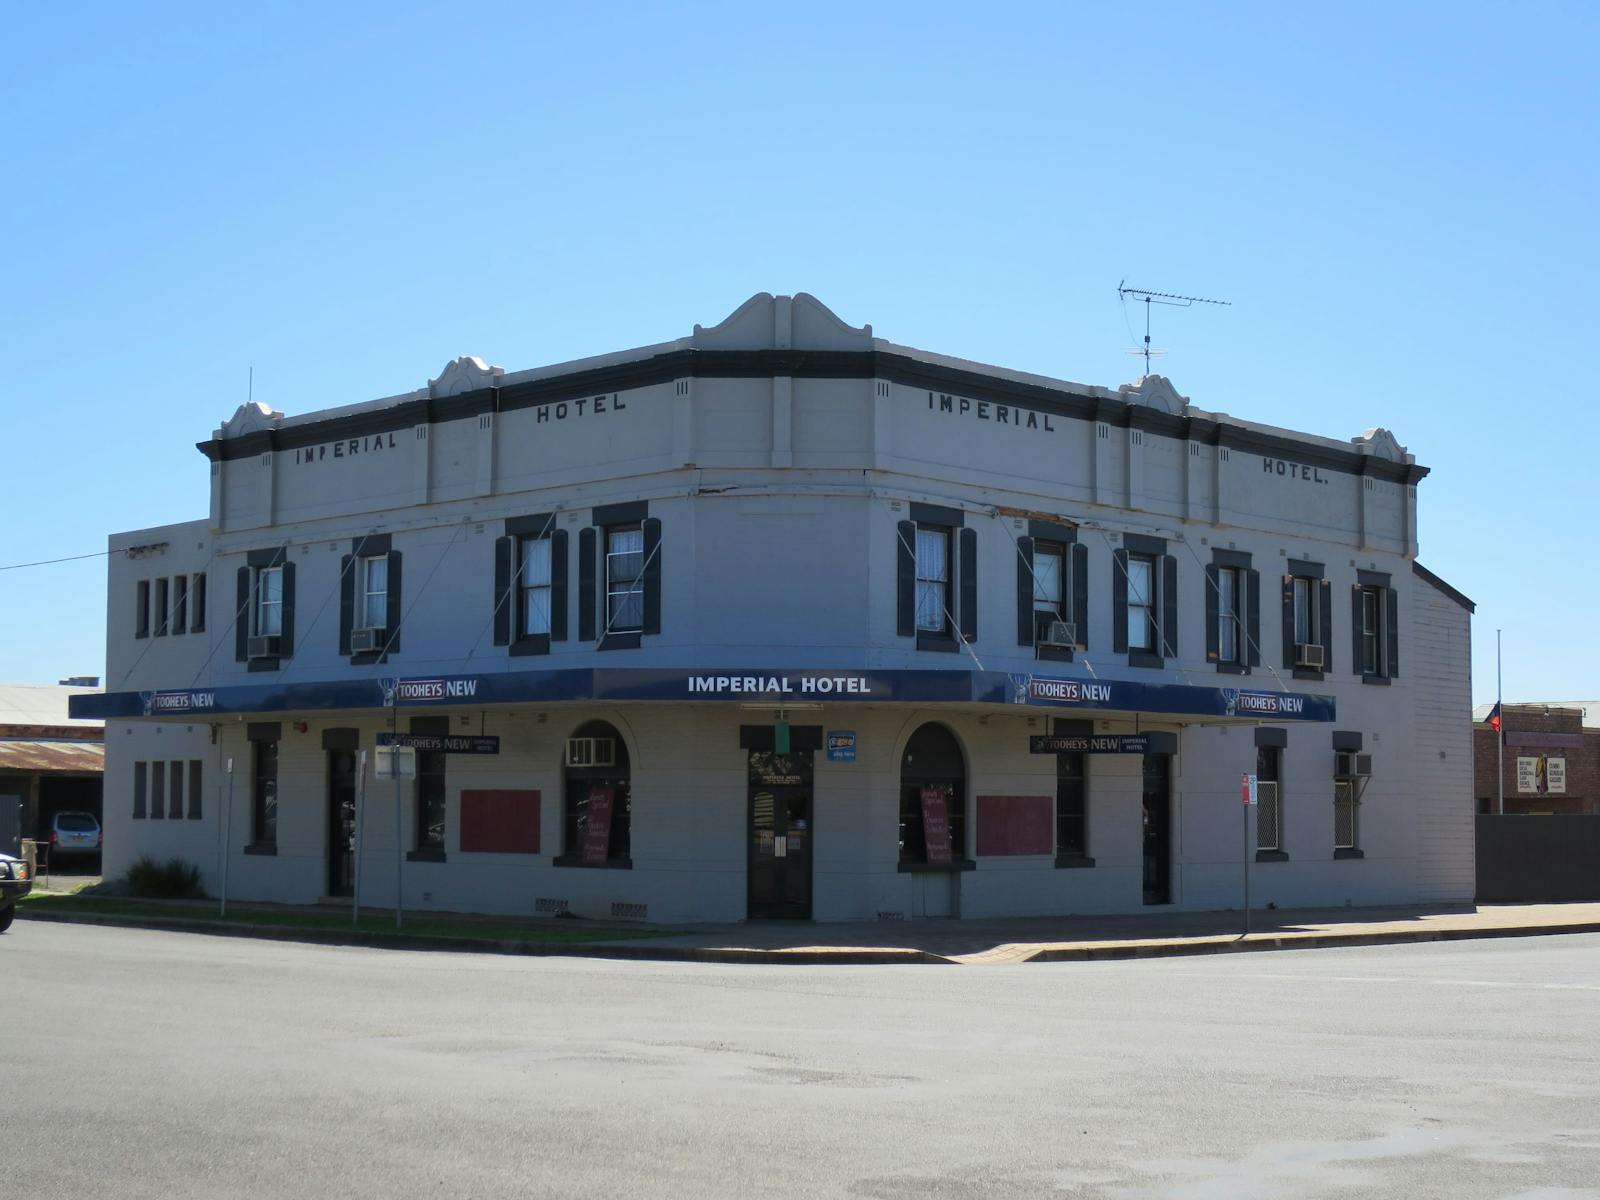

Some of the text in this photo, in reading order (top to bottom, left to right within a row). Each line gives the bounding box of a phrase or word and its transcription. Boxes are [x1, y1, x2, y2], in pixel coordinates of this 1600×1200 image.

[537, 394, 625, 423] HOTEL
[929, 392, 1054, 432] IMPERIAL
[296, 433, 395, 464] IMPERIAL
[400, 680, 477, 697] TOOHEYS NEW
[688, 677, 870, 692] IMPERIAL HOTEL
[1032, 682, 1111, 701] TOOHEYS NEW
[156, 692, 214, 708] TOOHEYS NEW
[1240, 696, 1303, 712] TOOHEYS NEW
[404, 738, 441, 749] TOOHEYS
[444, 739, 470, 749] NEW
[1048, 738, 1118, 750] TOOHEYS NEW
